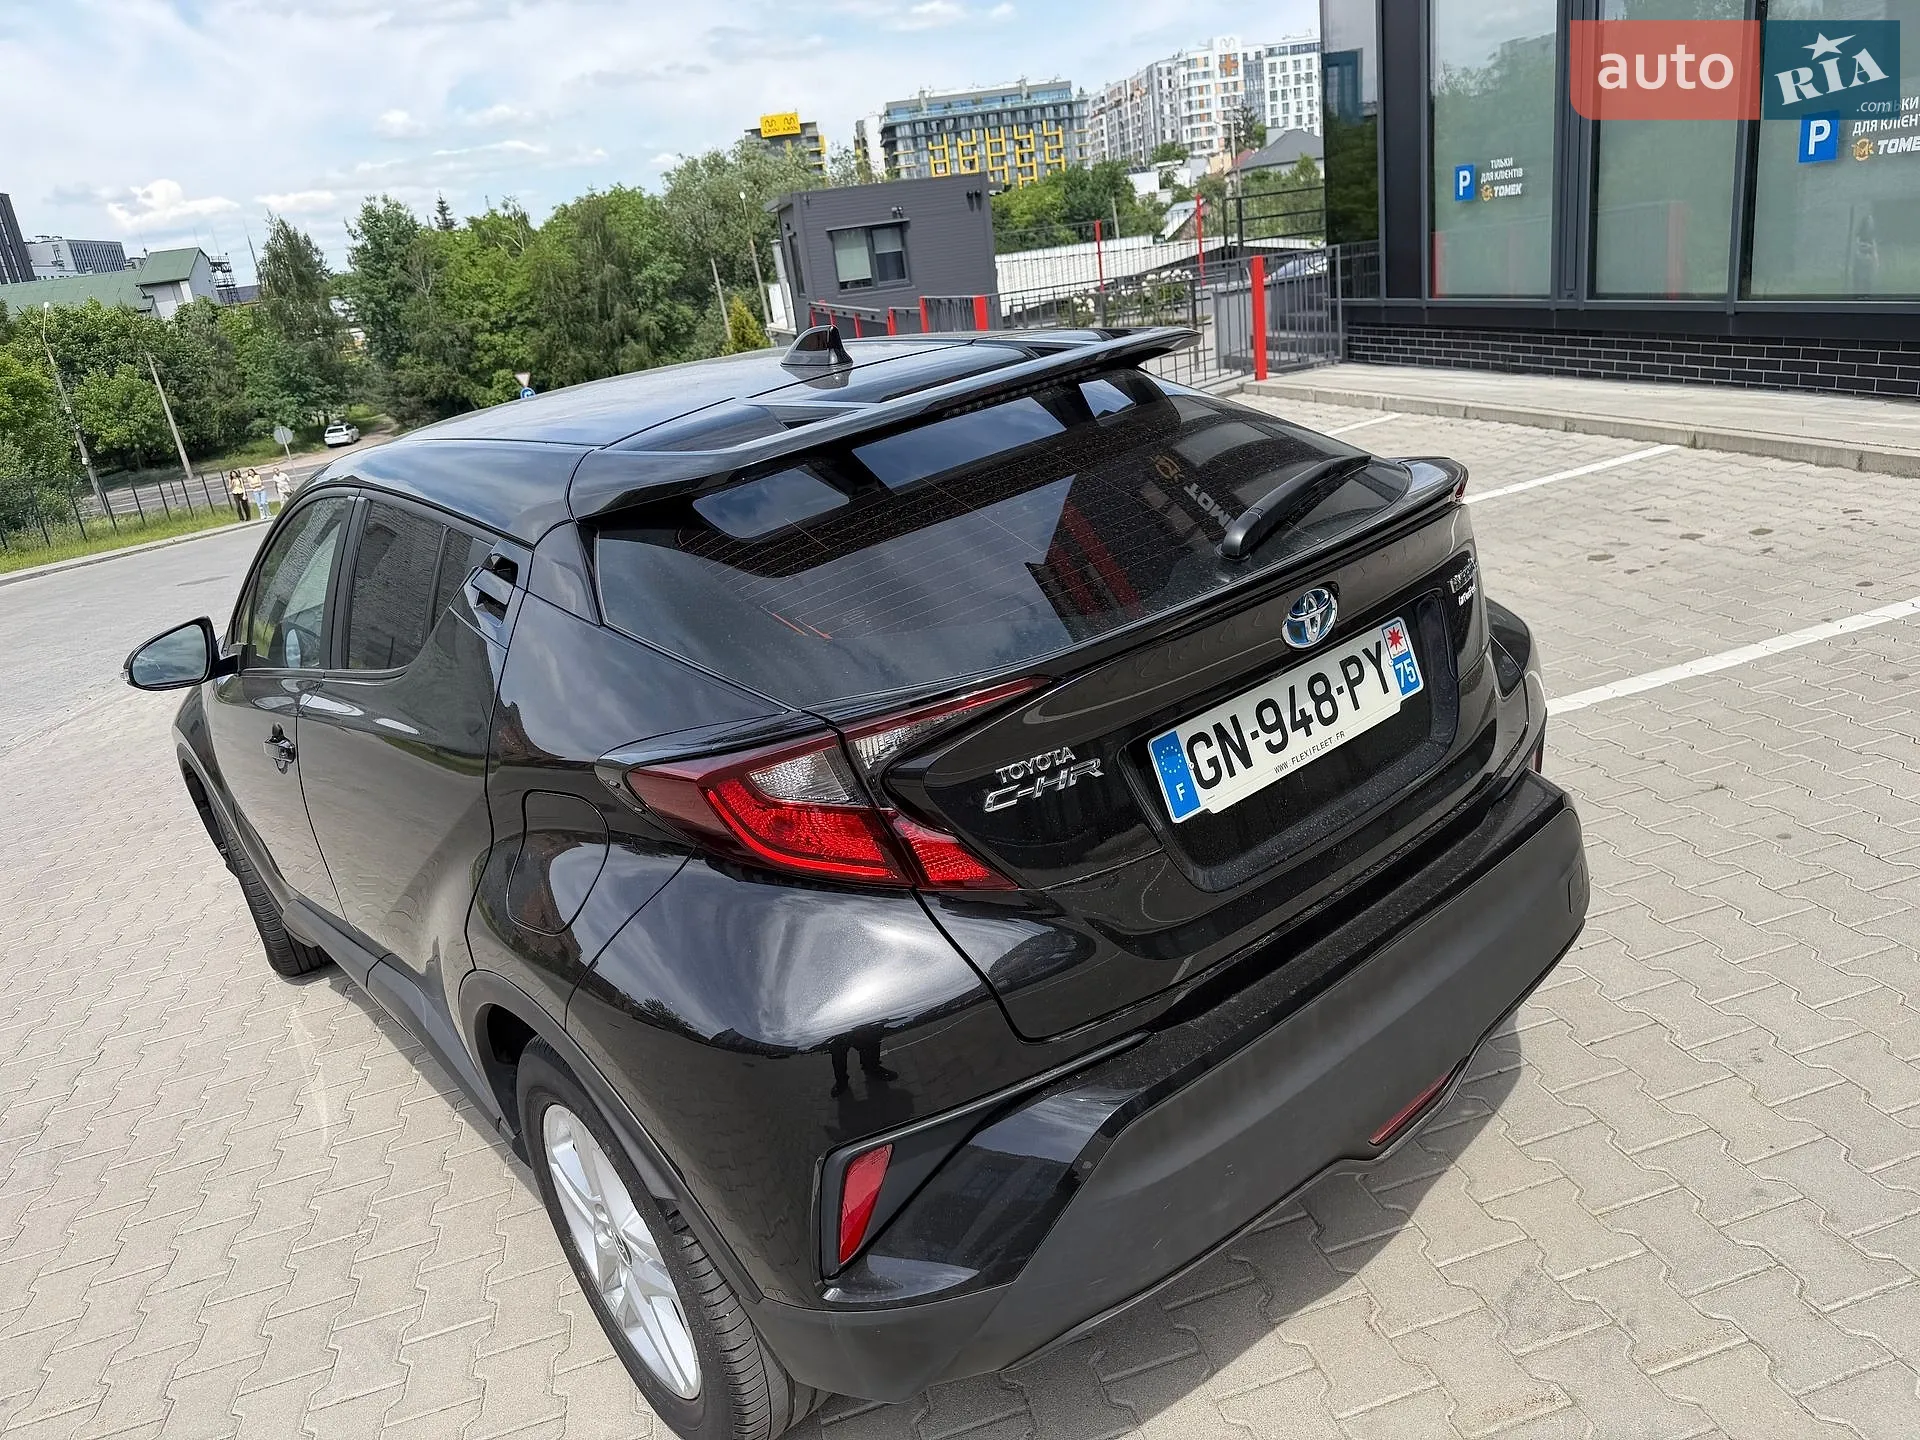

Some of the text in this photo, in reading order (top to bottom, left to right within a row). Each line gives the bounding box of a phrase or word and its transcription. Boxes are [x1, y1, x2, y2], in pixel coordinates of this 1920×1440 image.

[1808, 119, 1831, 156] P
[1852, 113, 1920, 136] ДЛЯ КЛІЄН
[1459, 170, 1471, 196] P
[1395, 657, 1417, 689] 75
[1186, 641, 1390, 790] GN-948-PY
[995, 746, 1077, 784] TOYOTA
[984, 758, 1105, 812] C-HR
[1176, 782, 1187, 801] F
